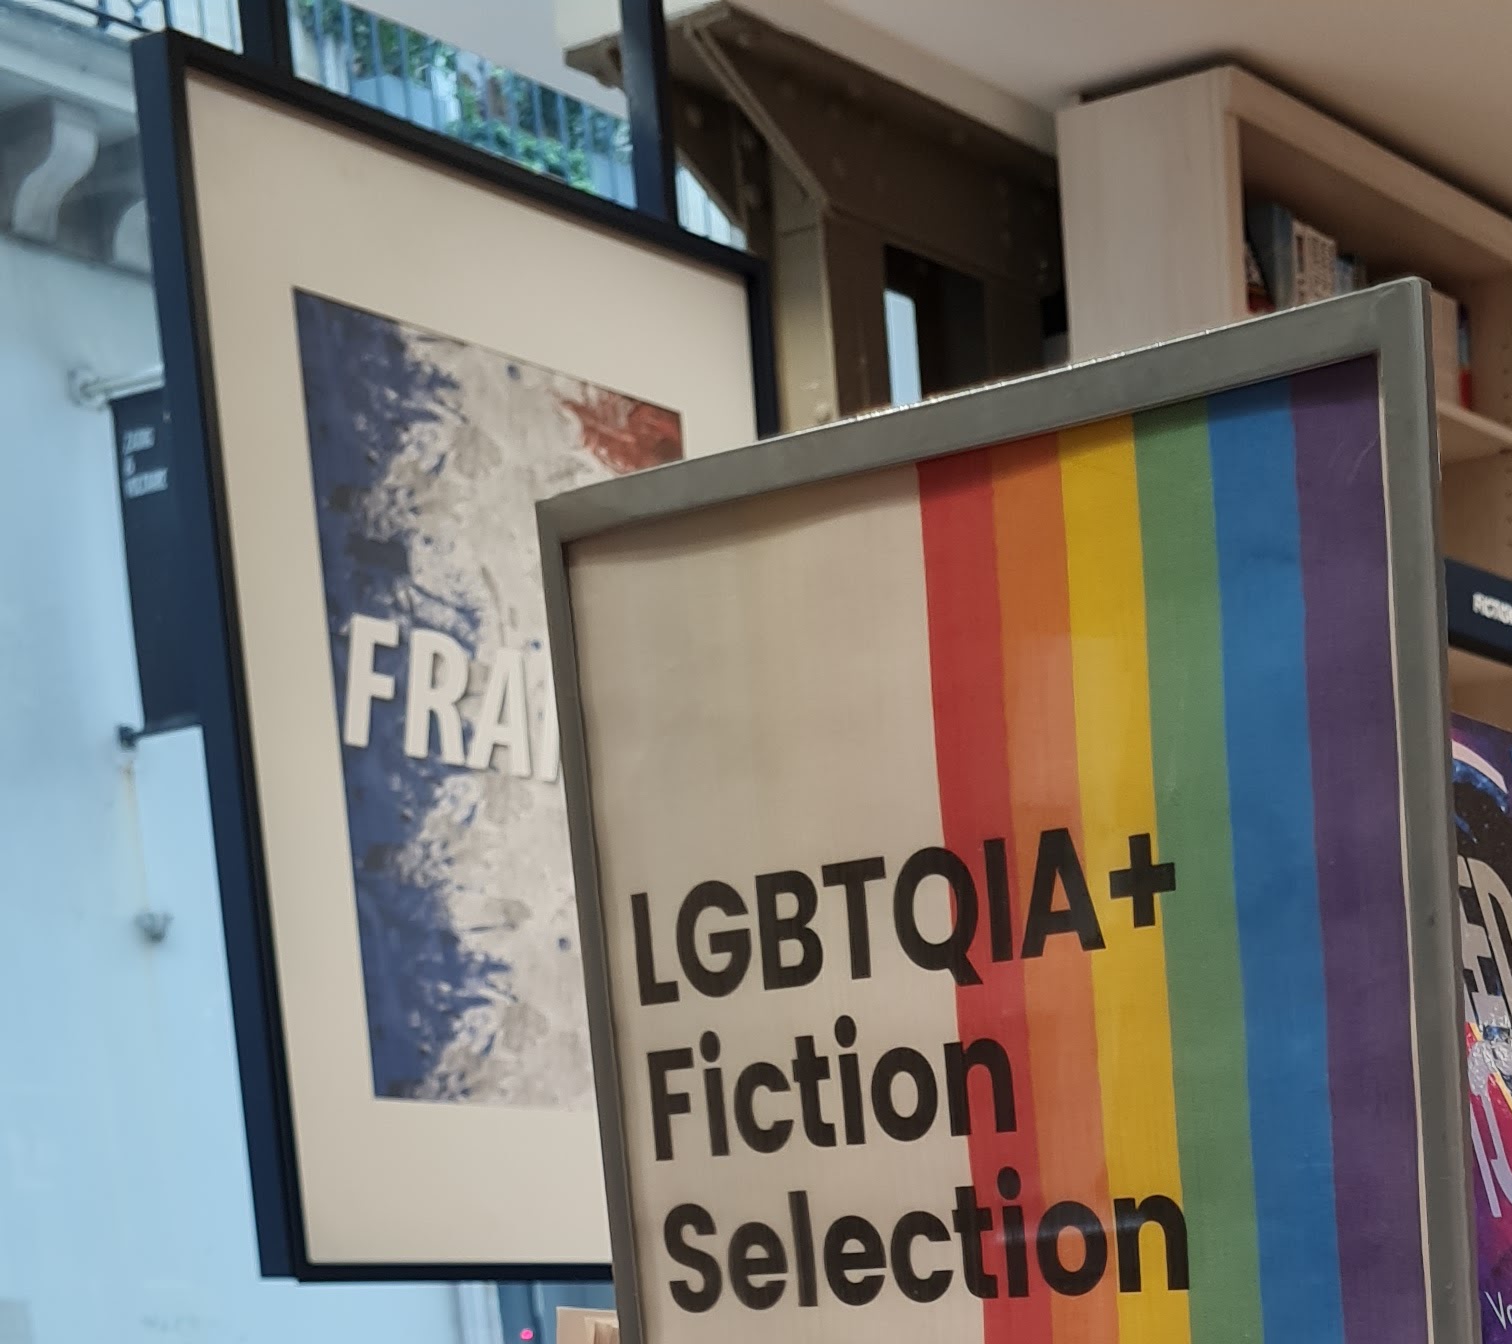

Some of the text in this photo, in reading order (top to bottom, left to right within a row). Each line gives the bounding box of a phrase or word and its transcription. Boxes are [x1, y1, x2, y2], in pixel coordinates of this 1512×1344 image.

[630, 828, 1176, 1006] LGBTQIA+
[647, 1015, 1017, 1161] Fiction
[664, 1166, 1189, 1313] Selection
